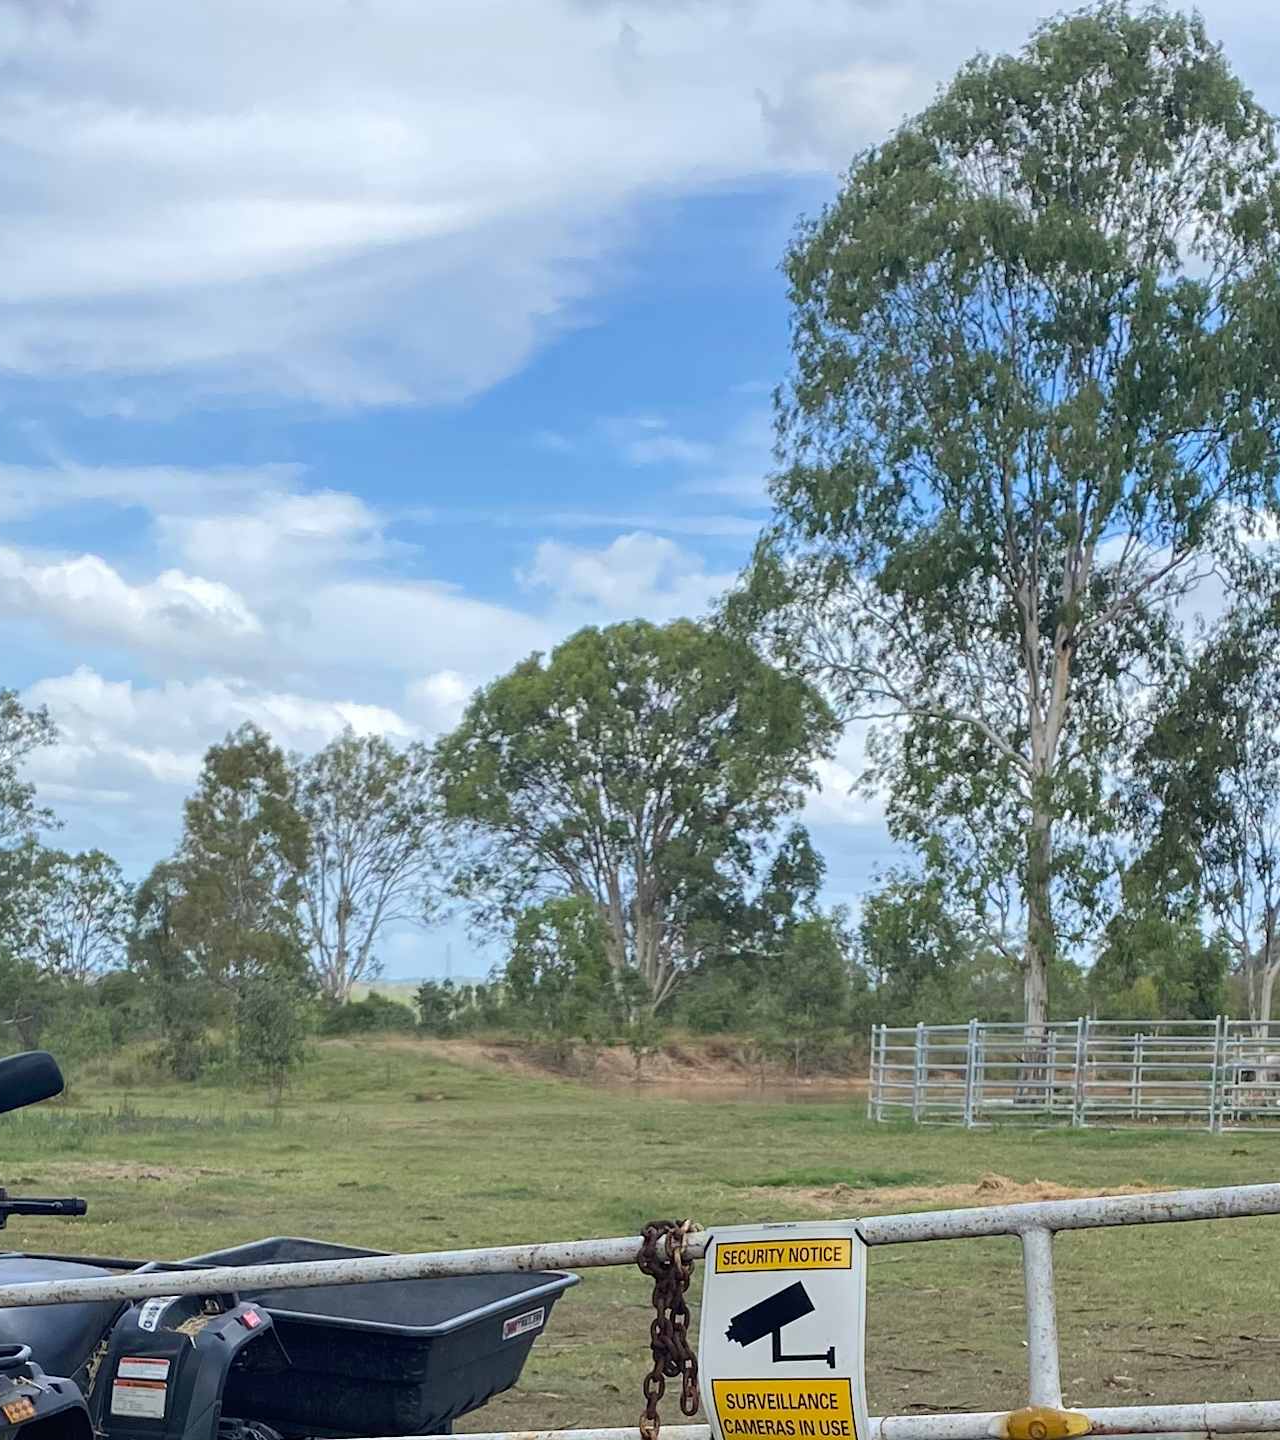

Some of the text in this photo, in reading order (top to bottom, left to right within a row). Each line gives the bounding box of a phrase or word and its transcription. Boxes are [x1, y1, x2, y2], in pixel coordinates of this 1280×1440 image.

[723, 1246, 842, 1265] SECURITY NOTICE
[726, 1393, 839, 1409] SURVEILLANCE
[723, 1420, 850, 1436] CAMERAS IN USE
